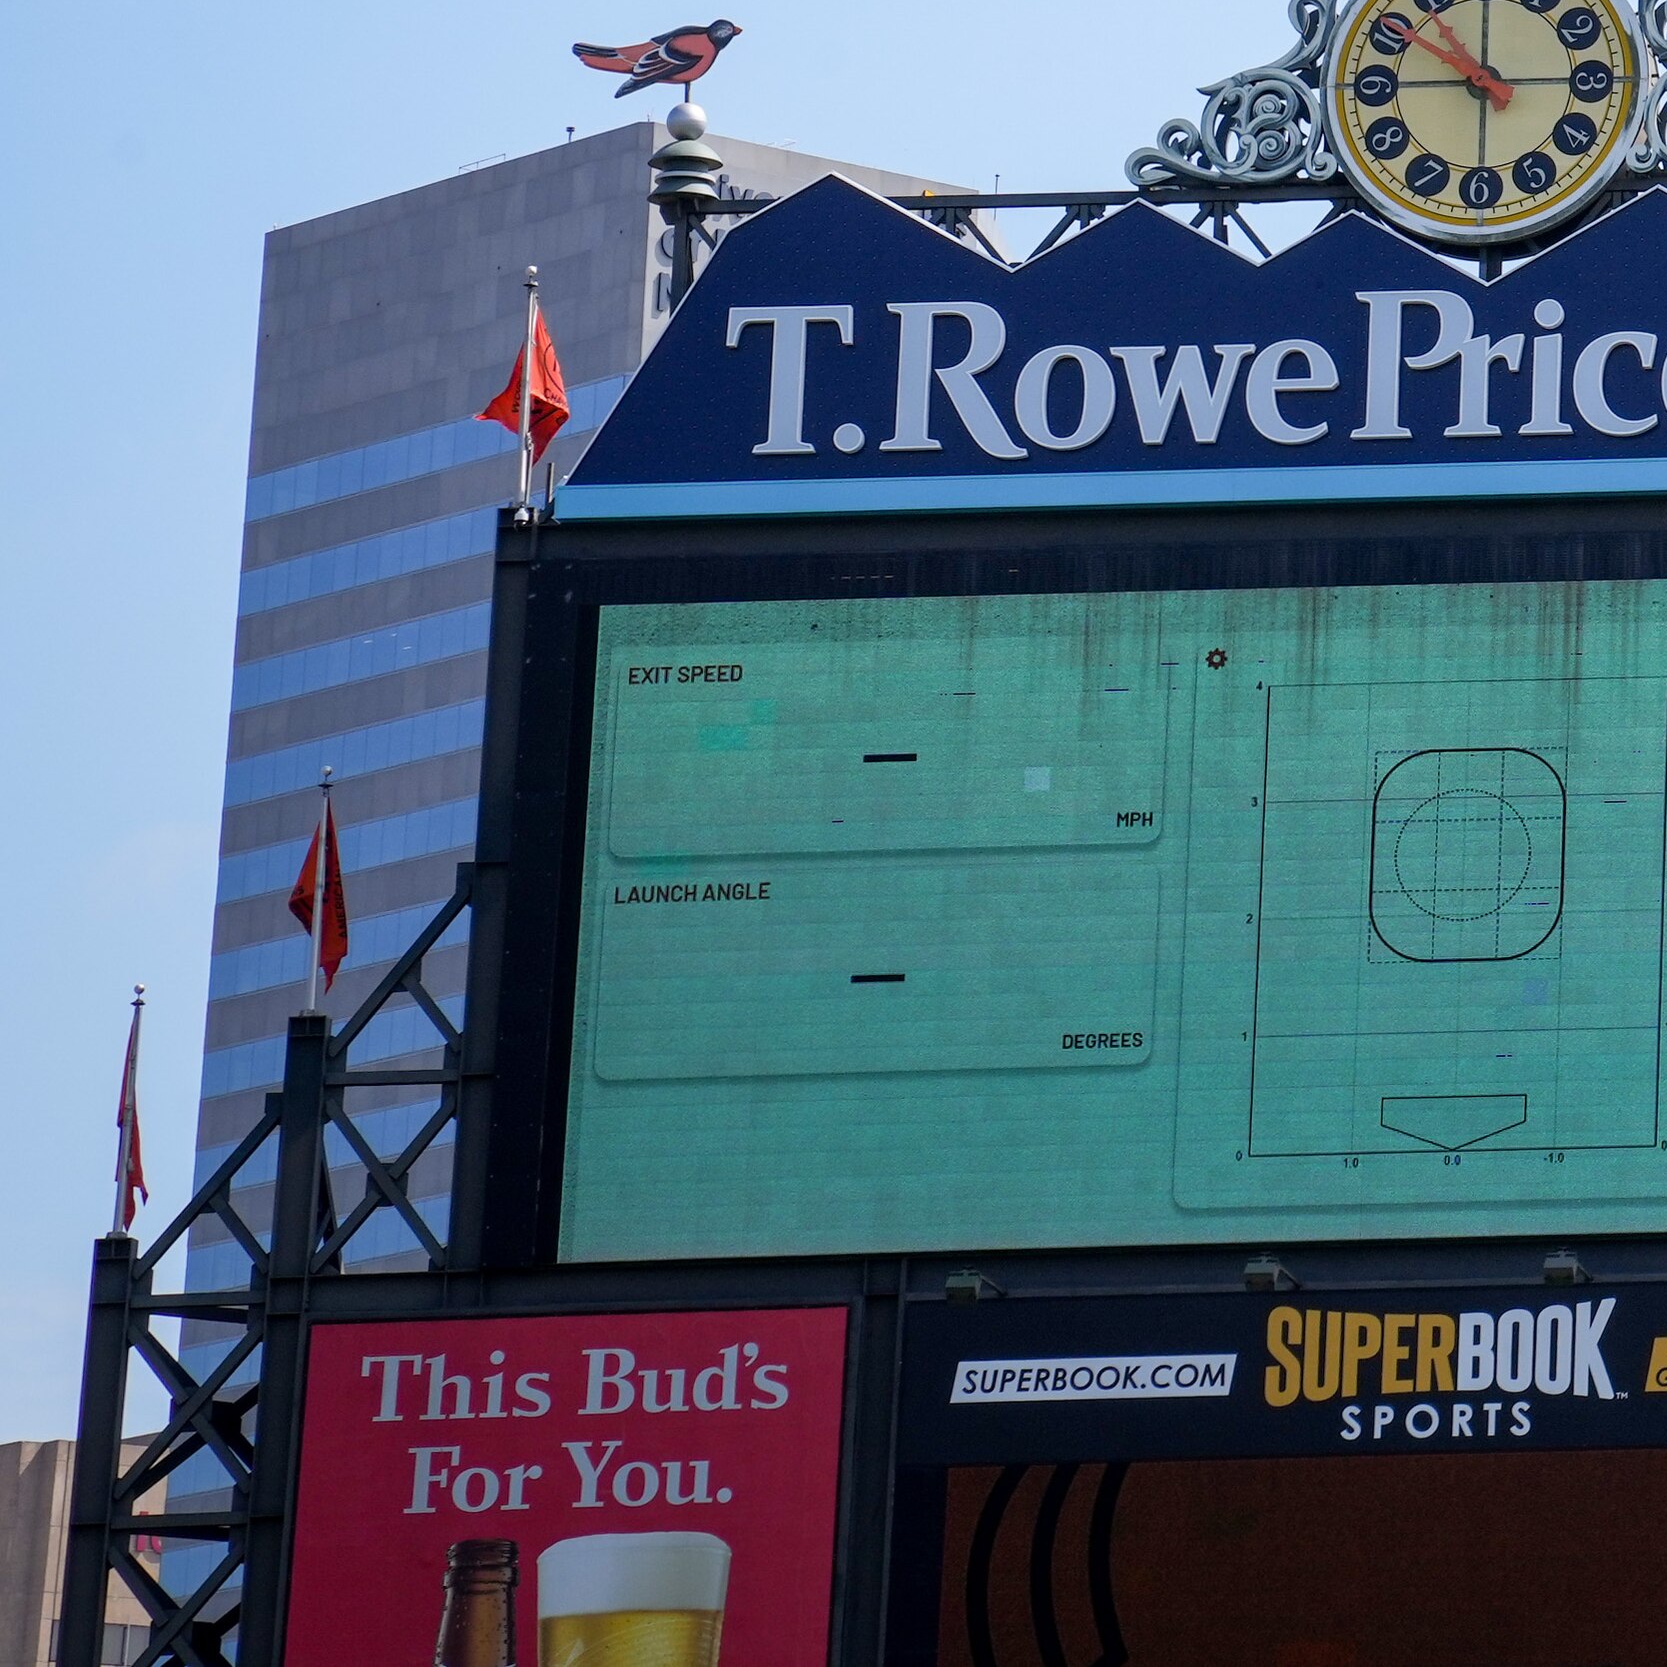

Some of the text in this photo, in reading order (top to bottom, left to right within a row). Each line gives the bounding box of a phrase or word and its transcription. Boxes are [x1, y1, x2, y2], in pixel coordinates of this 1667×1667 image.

[1565, 15, 1593, 42] 2
[1575, 72, 1607, 91] 3
[1371, 126, 1402, 150] 8
[1563, 124, 1590, 148] 4
[1415, 162, 1444, 188] 7
[1523, 157, 1546, 188] 5
[1468, 172, 1490, 204] 6
[629, 665, 743, 684] EXIT SPEED
[1251, 797, 1258, 807] 3
[1116, 812, 1154, 827] MPH
[614, 882, 771, 904] LAUNCH ANGLE
[1246, 914, 1253, 924] 2
[1062, 1032, 1143, 1050] DEGREES
[1344, 1158, 1359, 1168] 1.0
[1444, 1155, 1461, 1166] 0.0
[1543, 1153, 1565, 1164] -1.0
[1264, 1297, 1617, 1407] SUPERBOOK
[361, 1342, 789, 1422] This Bud's
[962, 1363, 1226, 1394] SUPERBOOK.COM
[1340, 1401, 1532, 1440] SPORTS
[403, 1440, 733, 1514] For You.
